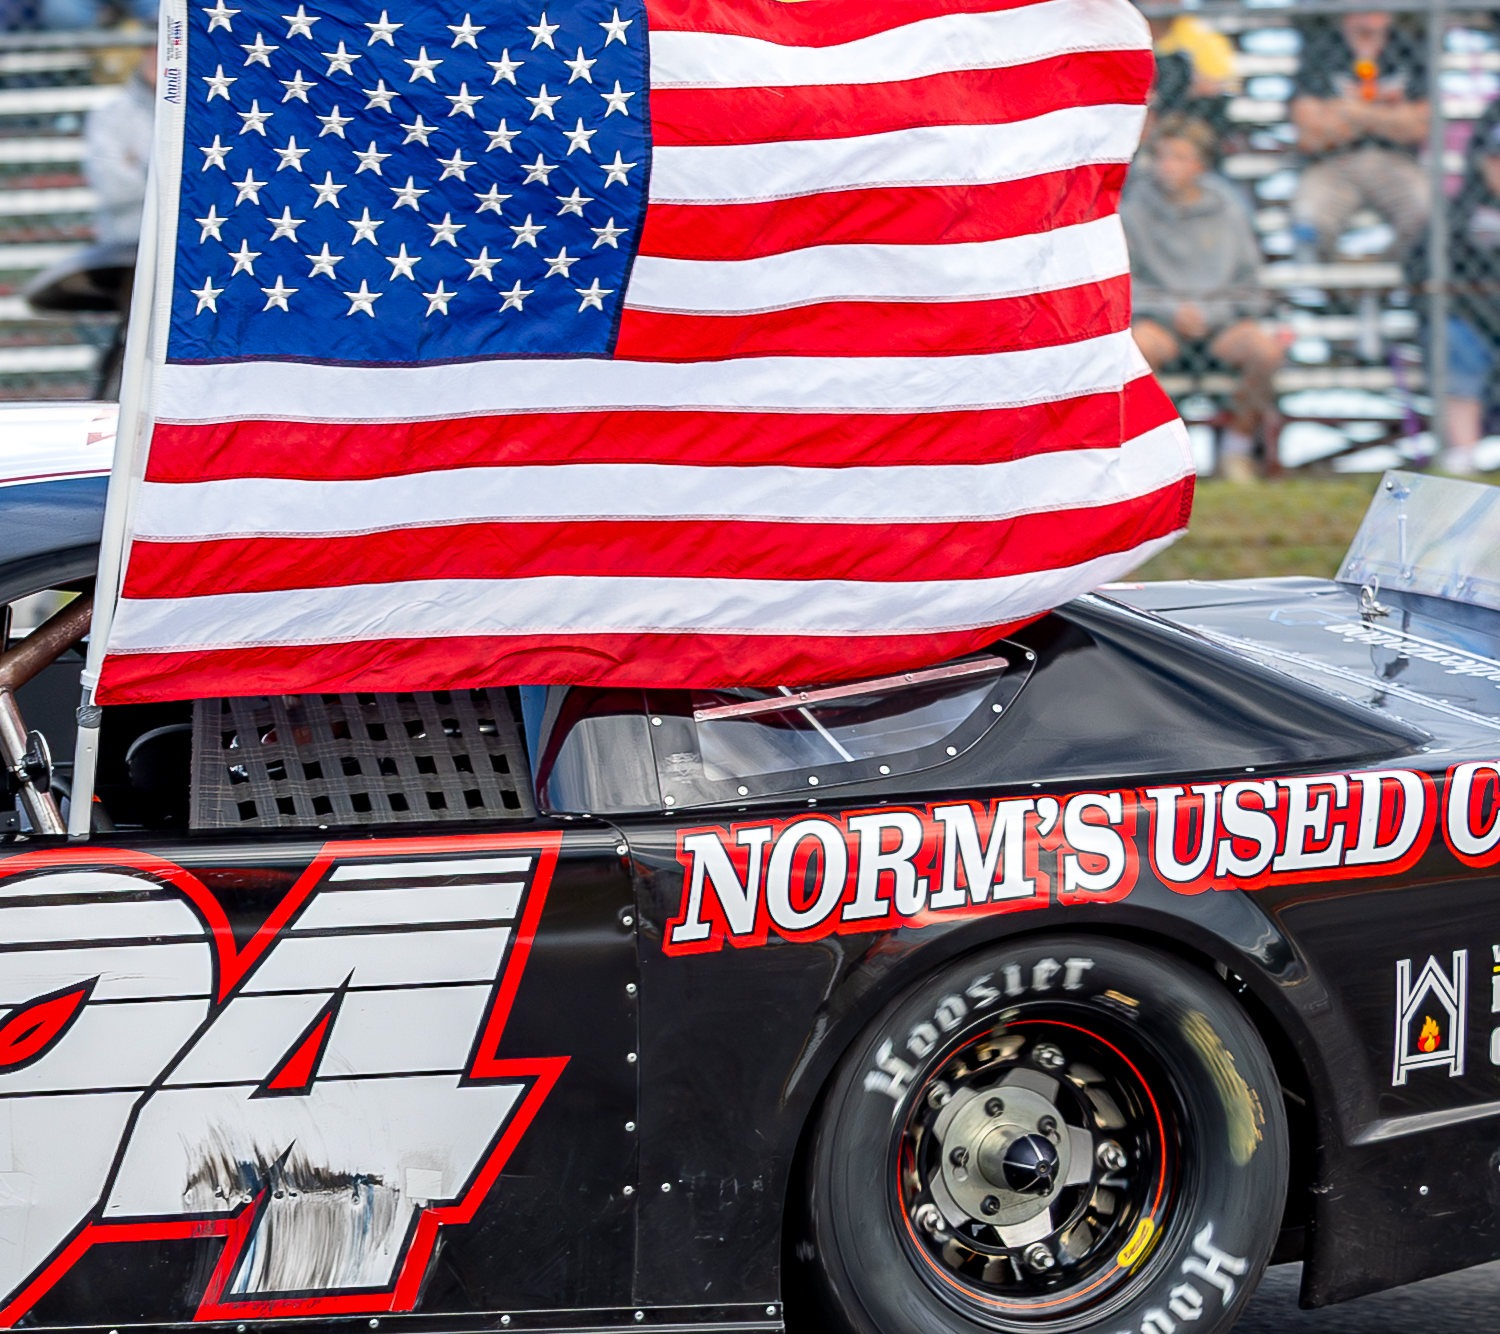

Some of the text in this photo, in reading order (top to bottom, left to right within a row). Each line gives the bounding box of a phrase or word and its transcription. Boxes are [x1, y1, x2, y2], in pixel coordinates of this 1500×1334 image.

[163, 67, 180, 104] Annin
[668, 786, 1130, 947] NORM'S
[1144, 768, 1434, 884] USED
[864, 957, 1096, 1104] Hoosier
